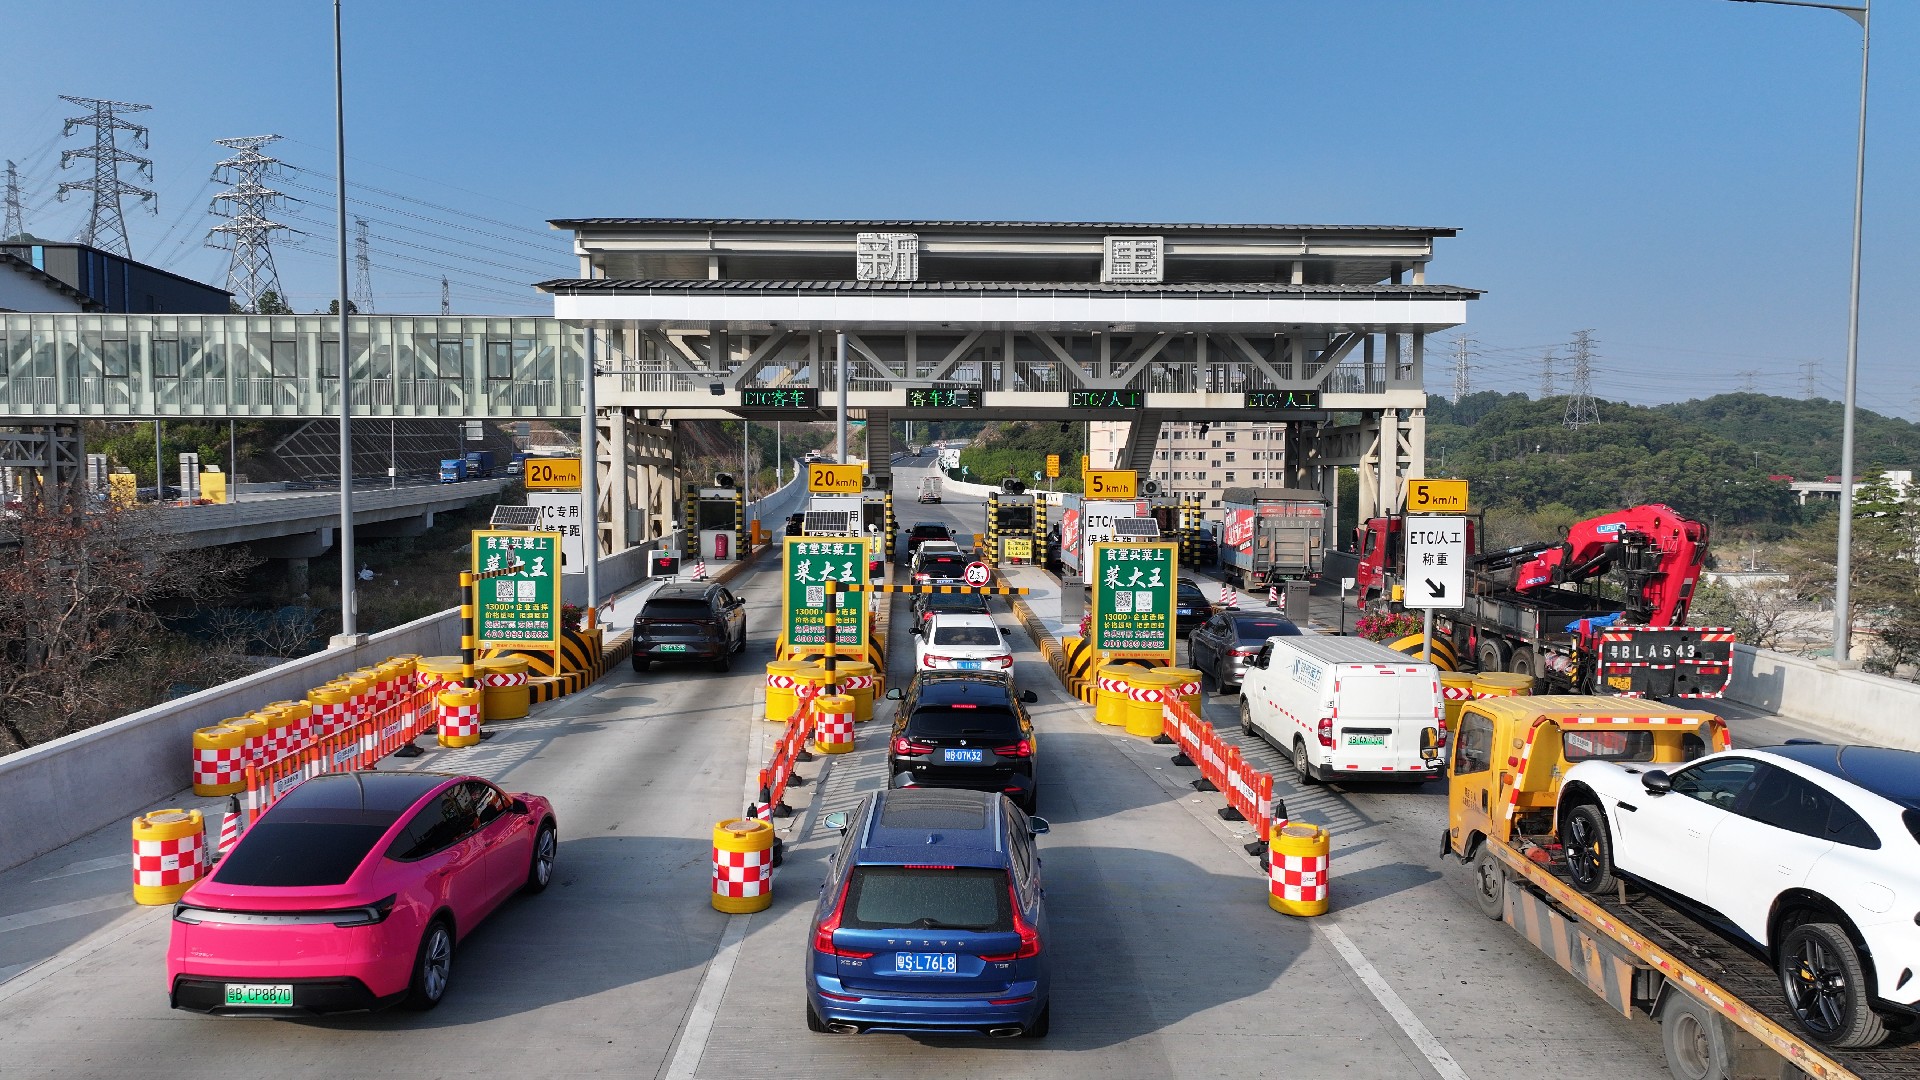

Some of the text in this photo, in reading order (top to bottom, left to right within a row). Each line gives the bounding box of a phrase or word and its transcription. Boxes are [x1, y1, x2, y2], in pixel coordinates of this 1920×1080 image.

[745, 389, 806, 407] ETC客车
[1072, 391, 1140, 407] ETC/人工
[1249, 391, 1316, 407] ETC/人工
[531, 466, 577, 482] 20 km/h
[814, 470, 858, 487] 20 km/h
[1093, 475, 1129, 493] 5 km/h
[1417, 485, 1458, 505] 5 km/h
[541, 505, 579, 518] TC专用
[1600, 524, 1623, 532] LIPUT
[486, 536, 547, 550] 食堂买菜上
[1410, 531, 1462, 545] ETC/人工
[797, 543, 857, 555] 食堂买菜上
[1106, 548, 1165, 561] 食堂买菜上
[1422, 552, 1448, 566] 称重
[794, 559, 857, 584] 菜大王
[1104, 564, 1165, 590] 菜大王
[1610, 644, 1695, 659] 粤BLA543
